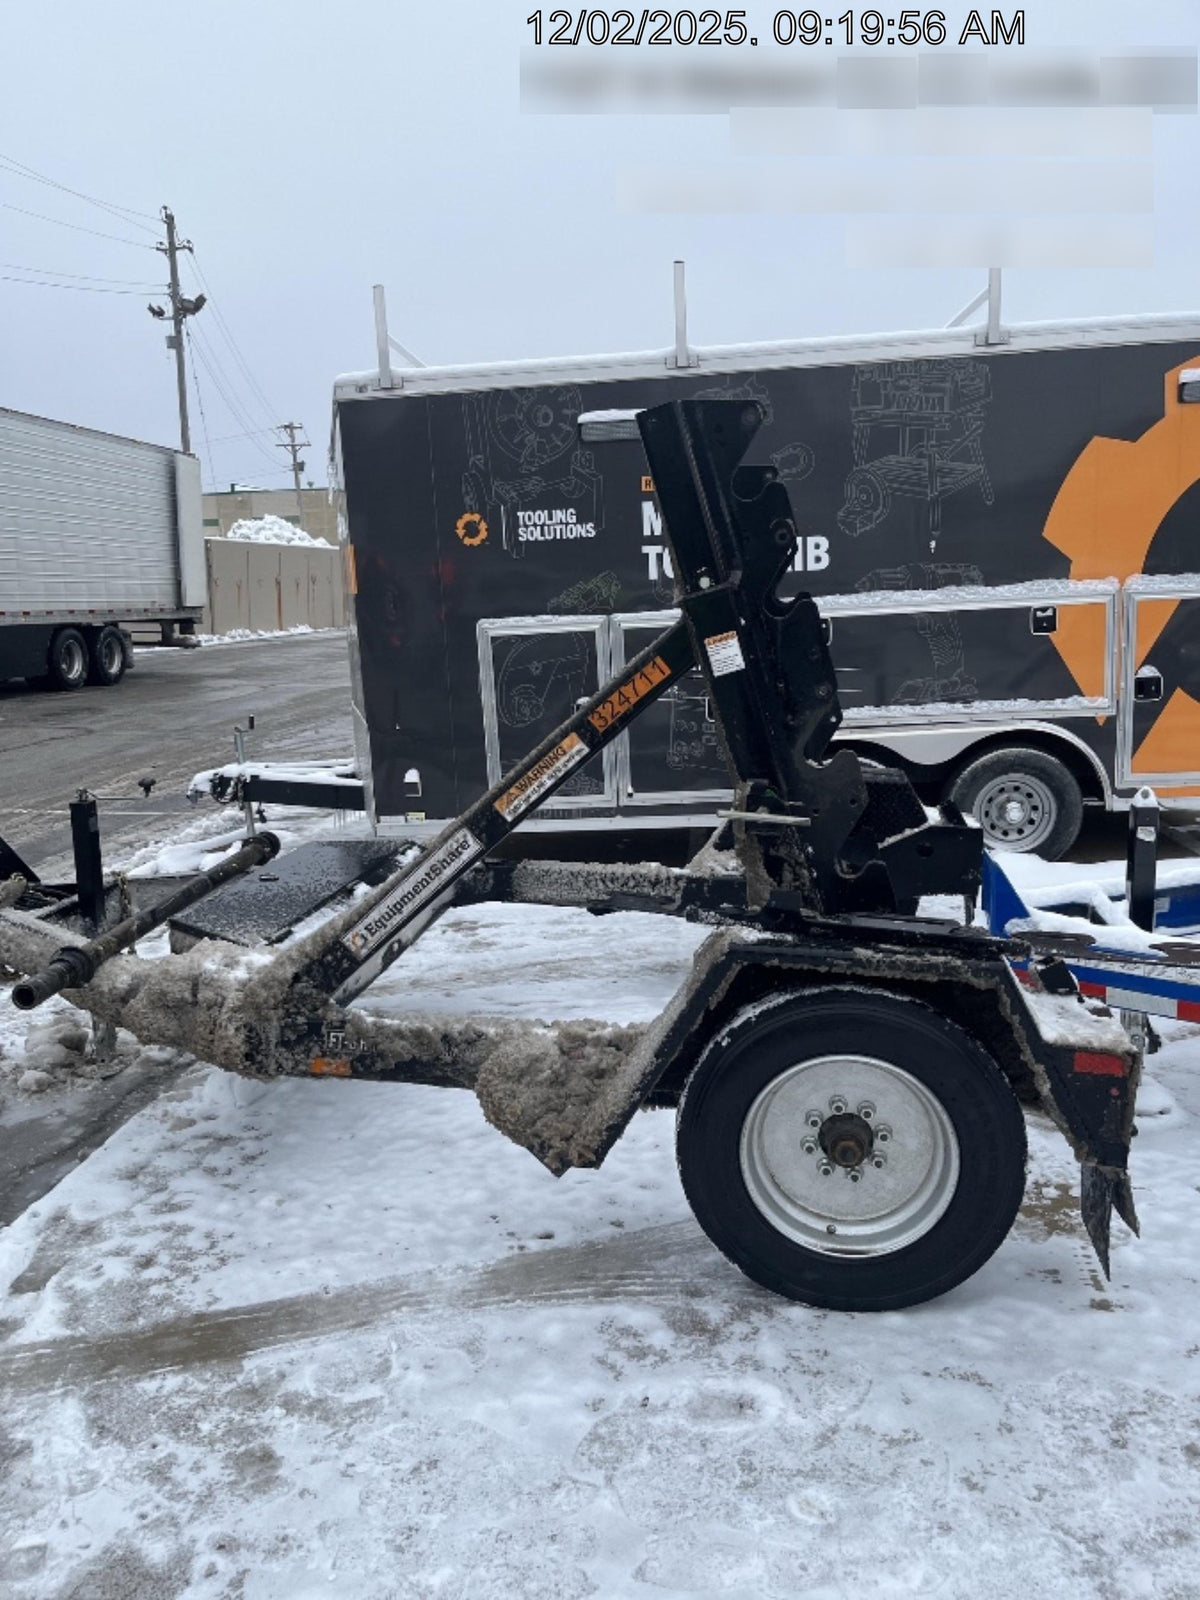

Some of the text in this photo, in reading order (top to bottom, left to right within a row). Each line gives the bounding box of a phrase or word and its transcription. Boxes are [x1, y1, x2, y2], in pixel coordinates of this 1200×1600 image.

[517, 508, 577, 527] TOOLING
[518, 522, 596, 541] SOLUTIONS
[590, 660, 666, 728] 324711
[515, 746, 566, 792] WARNING
[363, 839, 470, 937] EquipmentShare
